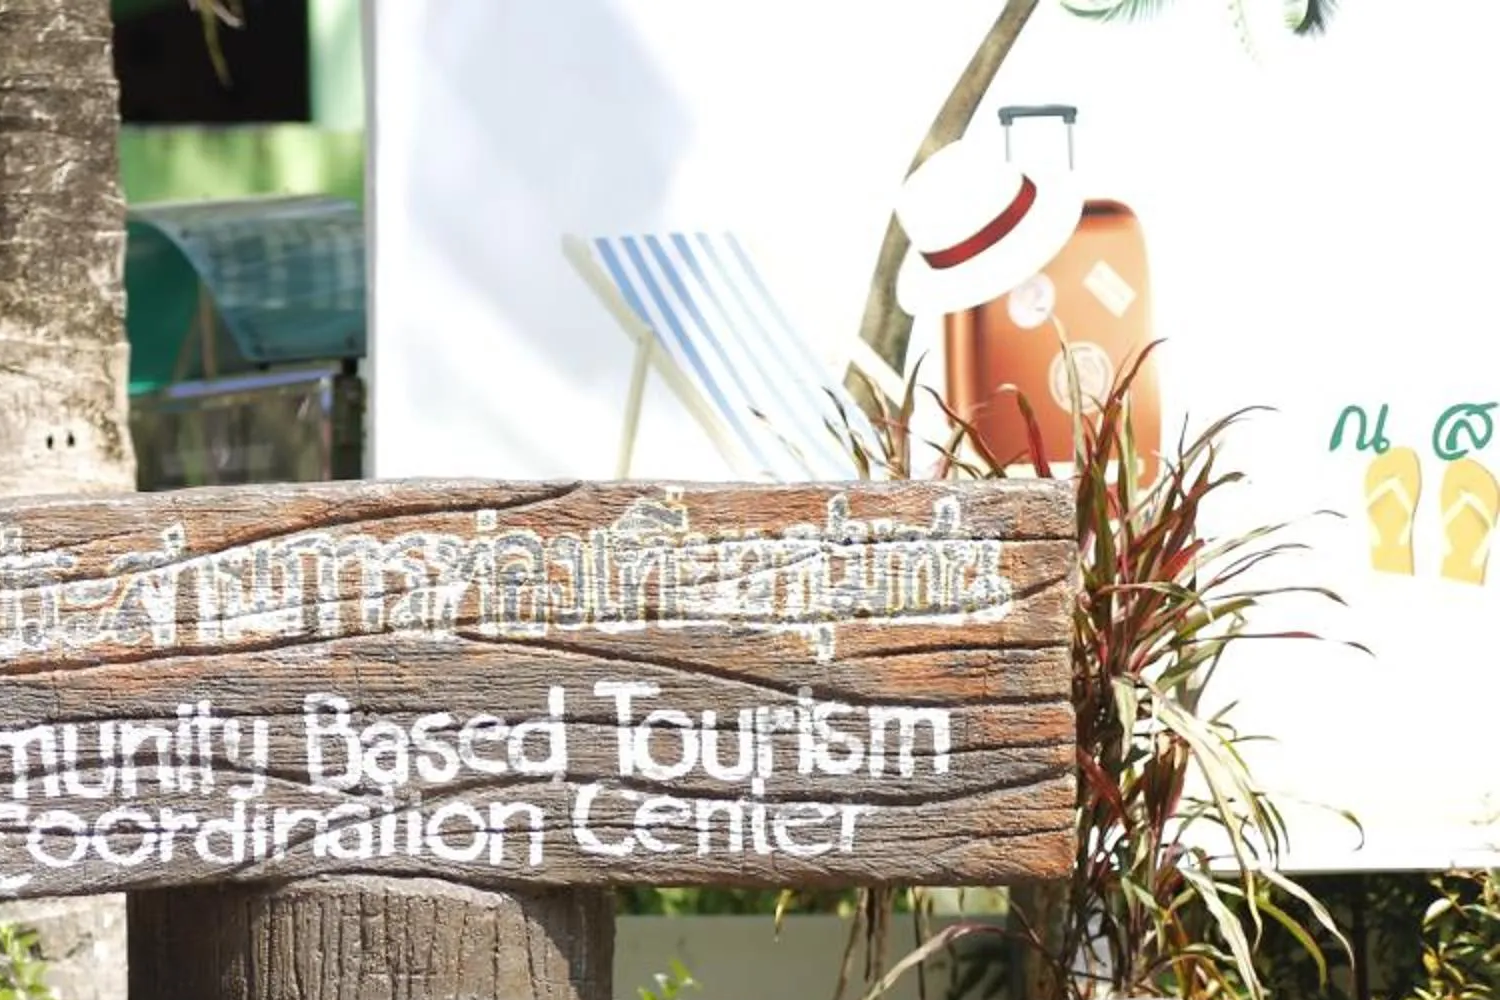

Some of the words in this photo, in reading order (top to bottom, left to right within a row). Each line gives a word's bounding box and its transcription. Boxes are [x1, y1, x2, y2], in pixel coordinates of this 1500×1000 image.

[303, 686, 567, 789] Based
[594, 681, 951, 780] Tourism
[573, 778, 874, 856] Center
